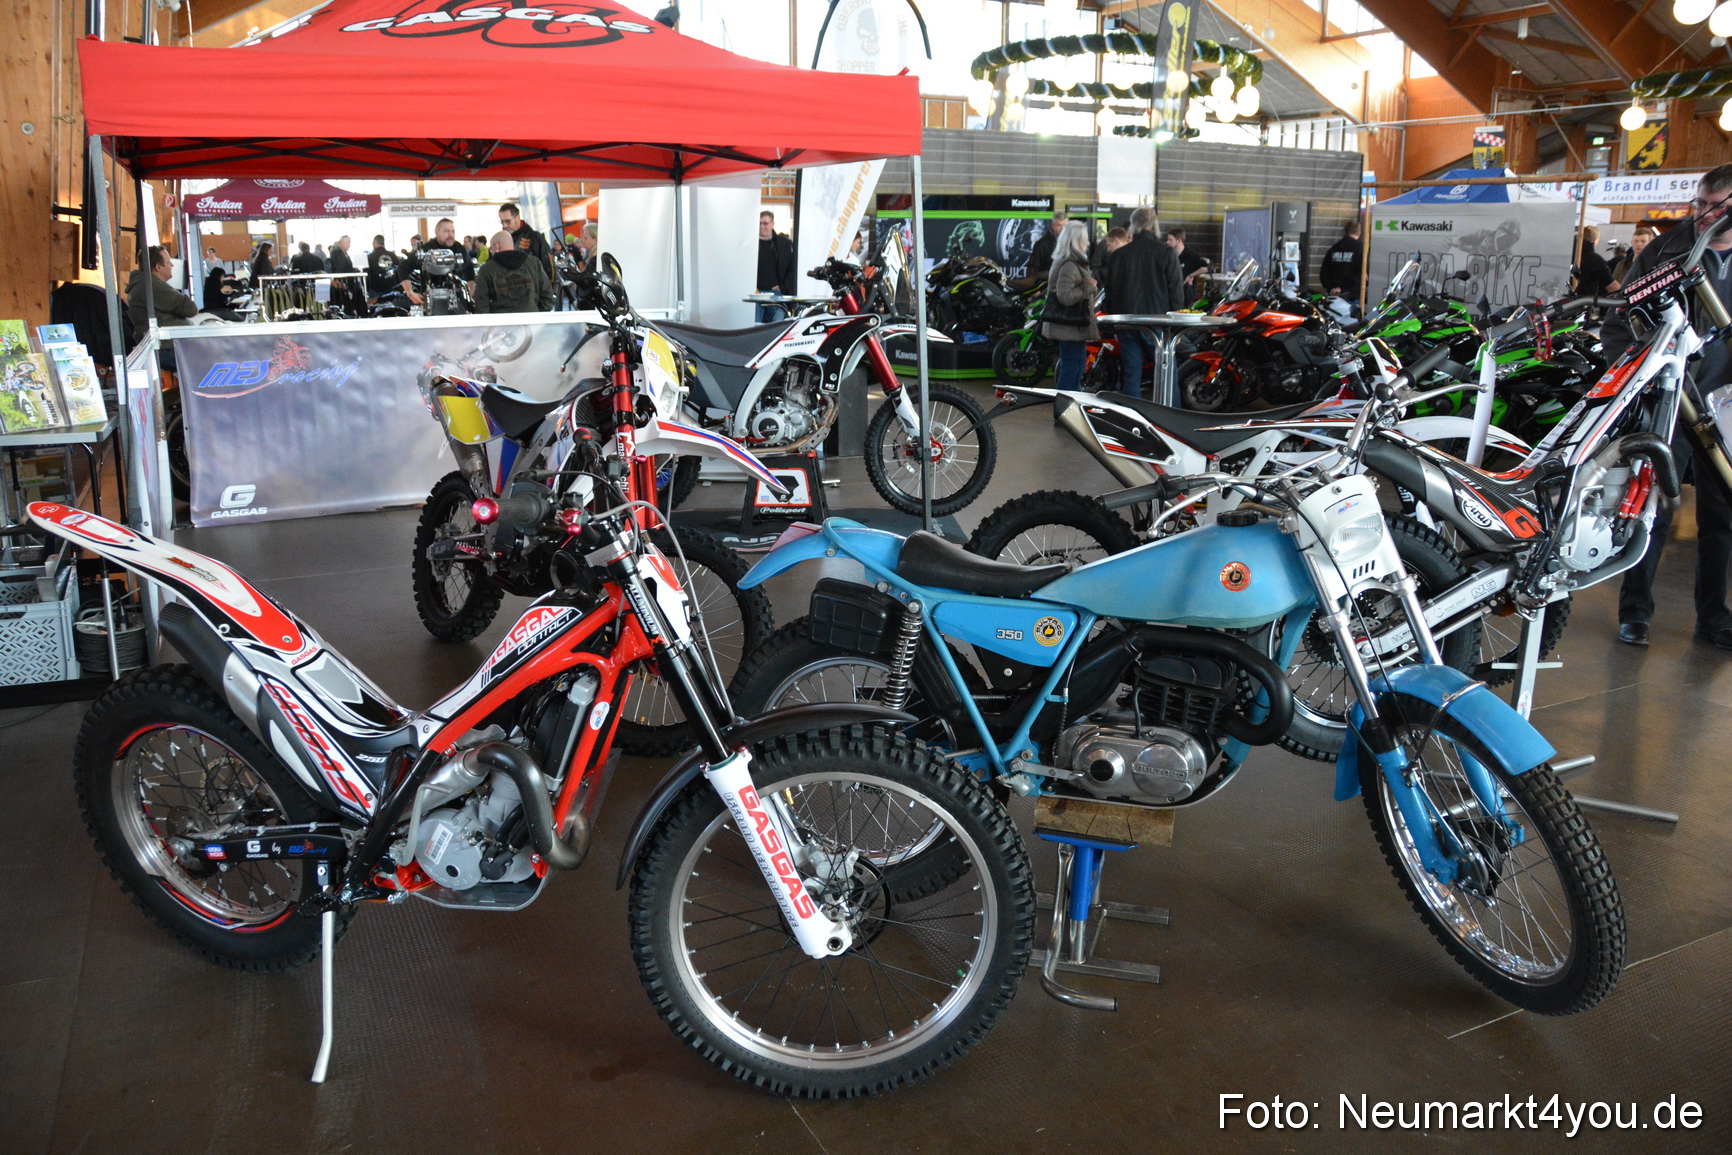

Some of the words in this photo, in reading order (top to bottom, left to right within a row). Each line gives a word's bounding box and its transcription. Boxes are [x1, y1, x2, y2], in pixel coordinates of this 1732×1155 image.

[340, 7, 654, 33] GASGAS
[1603, 178, 1660, 192] Brandl
[196, 196, 243, 210] Indian
[261, 196, 306, 210] Indian
[323, 195, 368, 209] Indian
[1011, 198, 1050, 208] Kawasaki
[1400, 220, 1453, 231] Kawasaki
[1465, 253, 1542, 306] BIKE
[1629, 270, 1684, 304] RENTHAL
[809, 325, 826, 335] AJP
[784, 339, 816, 348] PERFORMANCE
[278, 357, 361, 388] racing
[1613, 364, 1636, 392] GASGAS
[211, 507, 267, 518] GASGAS
[760, 506, 806, 514] Polisport
[628, 583, 660, 635] ALUMINIUM
[517, 610, 573, 656] CONTACT
[1036, 617, 1062, 636] BULTACO
[995, 628, 1024, 642] 350
[291, 646, 319, 666] GASGAS
[264, 682, 372, 809] GASGAS
[355, 753, 388, 763] 250
[271, 842, 282, 855] by
[738, 784, 817, 921] GASGAS
[723, 791, 755, 843] OFFROAD
[751, 846, 800, 929] PERFORMANCE
